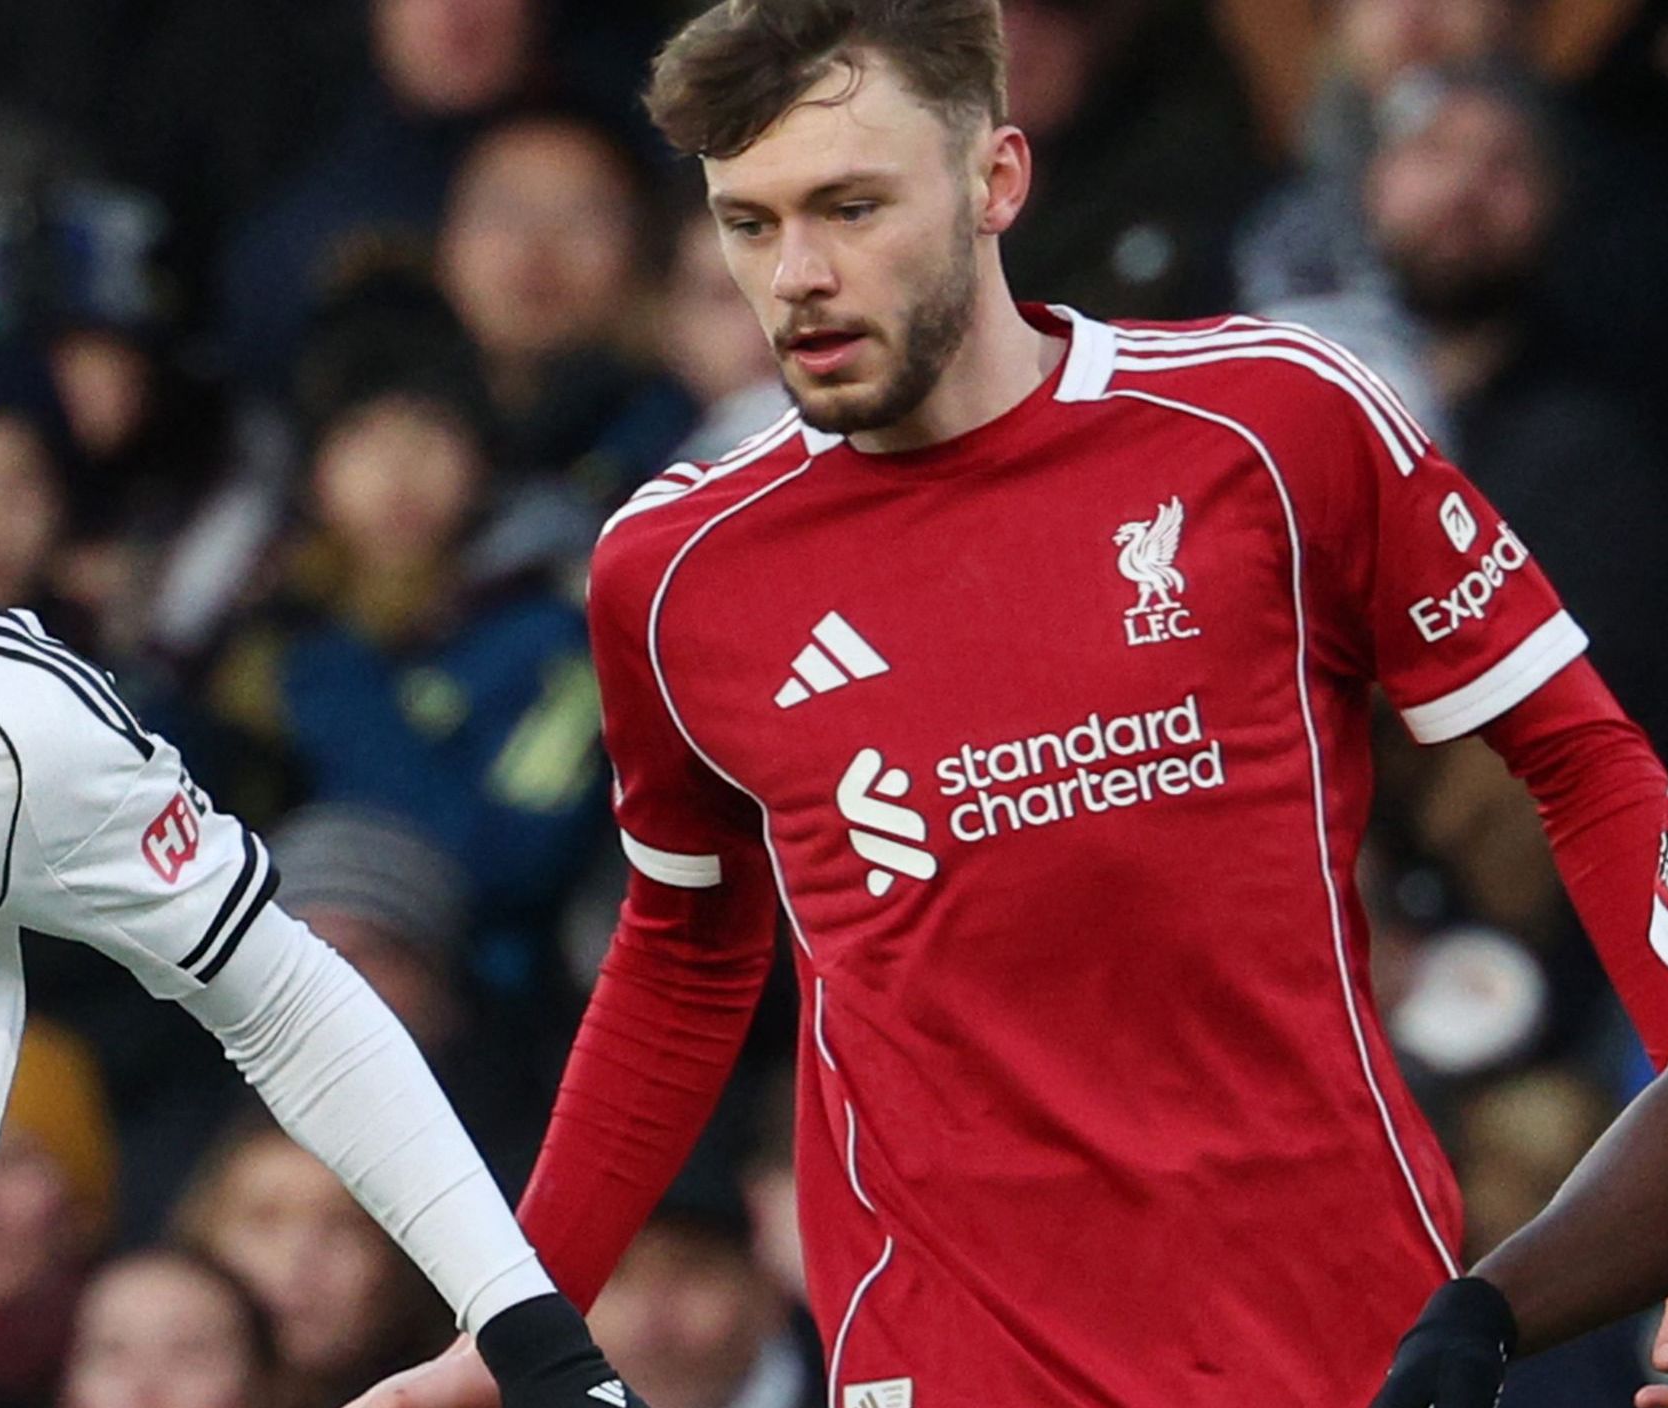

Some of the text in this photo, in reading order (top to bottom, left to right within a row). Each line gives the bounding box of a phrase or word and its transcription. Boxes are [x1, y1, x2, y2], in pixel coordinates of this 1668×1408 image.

[935, 694, 1202, 796] standard
[949, 739, 1225, 842] chartered
[147, 800, 196, 875] Hi
